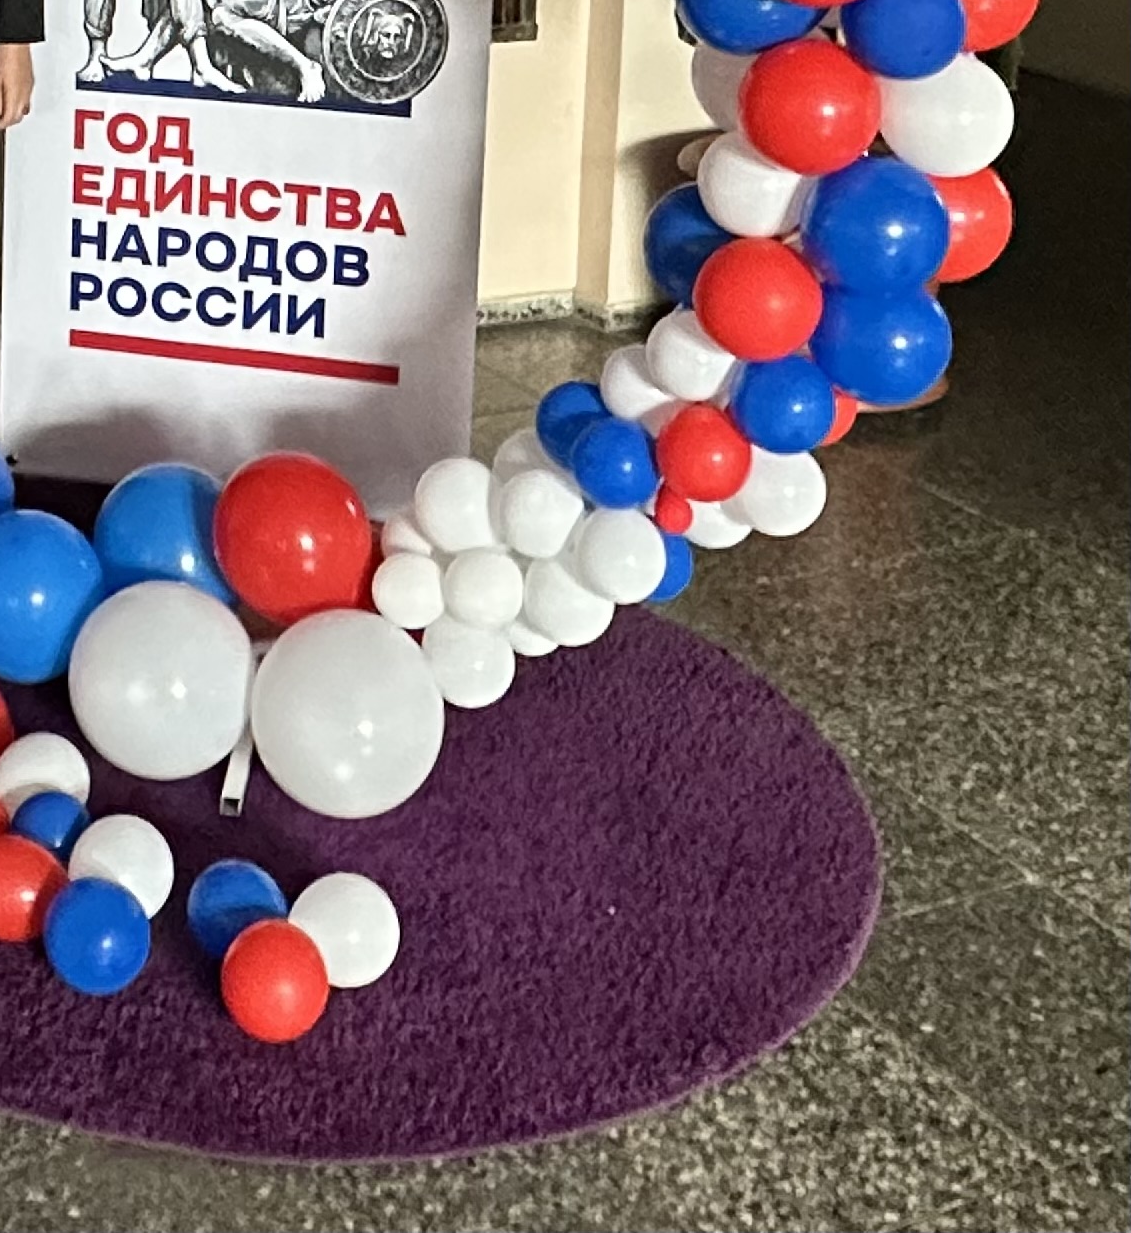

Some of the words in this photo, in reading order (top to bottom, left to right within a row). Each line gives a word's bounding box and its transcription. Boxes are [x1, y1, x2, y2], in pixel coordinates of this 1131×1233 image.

[73, 108, 194, 166] ГОД
[72, 164, 407, 236] ЕДИНСТВА
[71, 218, 370, 286] НАРОДОВ
[69, 272, 326, 338] РОССИИ
